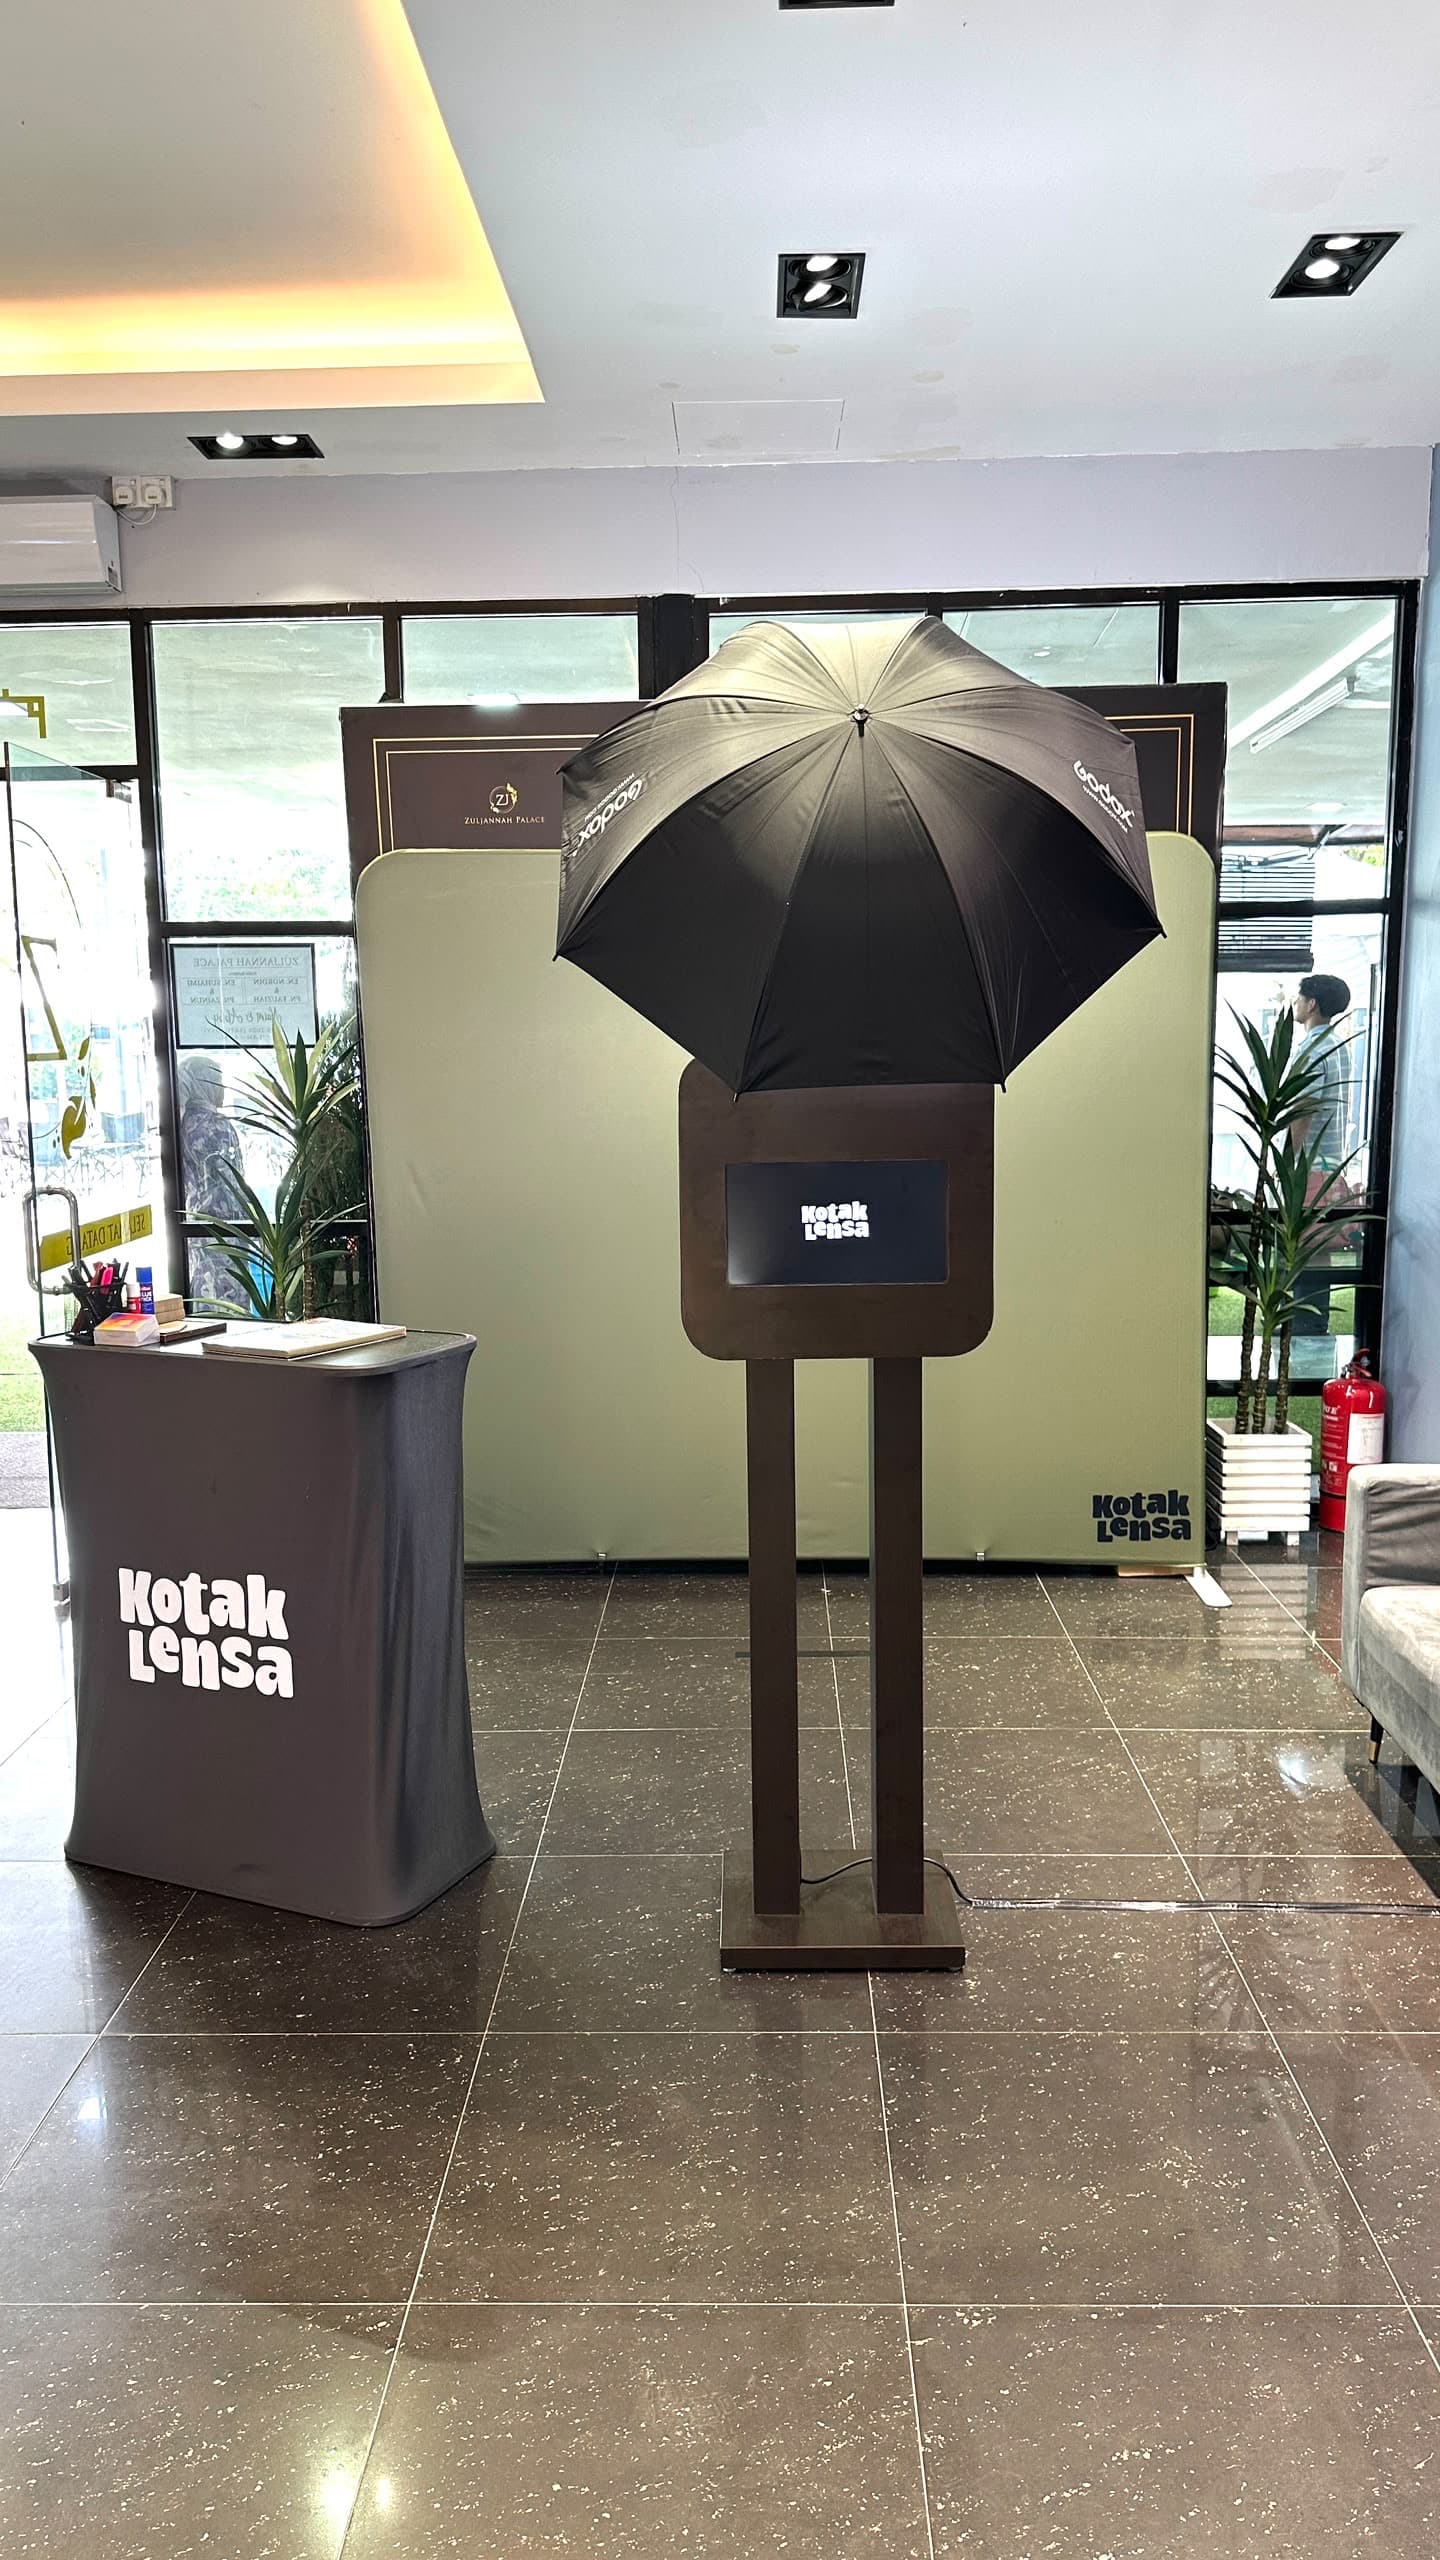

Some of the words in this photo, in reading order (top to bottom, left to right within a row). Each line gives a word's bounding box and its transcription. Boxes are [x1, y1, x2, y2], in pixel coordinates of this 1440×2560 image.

[495, 793, 509, 806] ZJ
[1072, 760, 1134, 828] Godox
[464, 816, 513, 825] ZULJANNAH
[515, 816, 545, 824] PALACE
[577, 779, 643, 848] Godox
[801, 1201, 868, 1223] Kotak
[805, 1220, 869, 1240] Lensa
[1092, 1489, 1190, 1518] Kotak
[1097, 1517, 1191, 1542] Lensa
[118, 1567, 290, 1640] Kotak
[128, 1625, 294, 1699] Lensa
